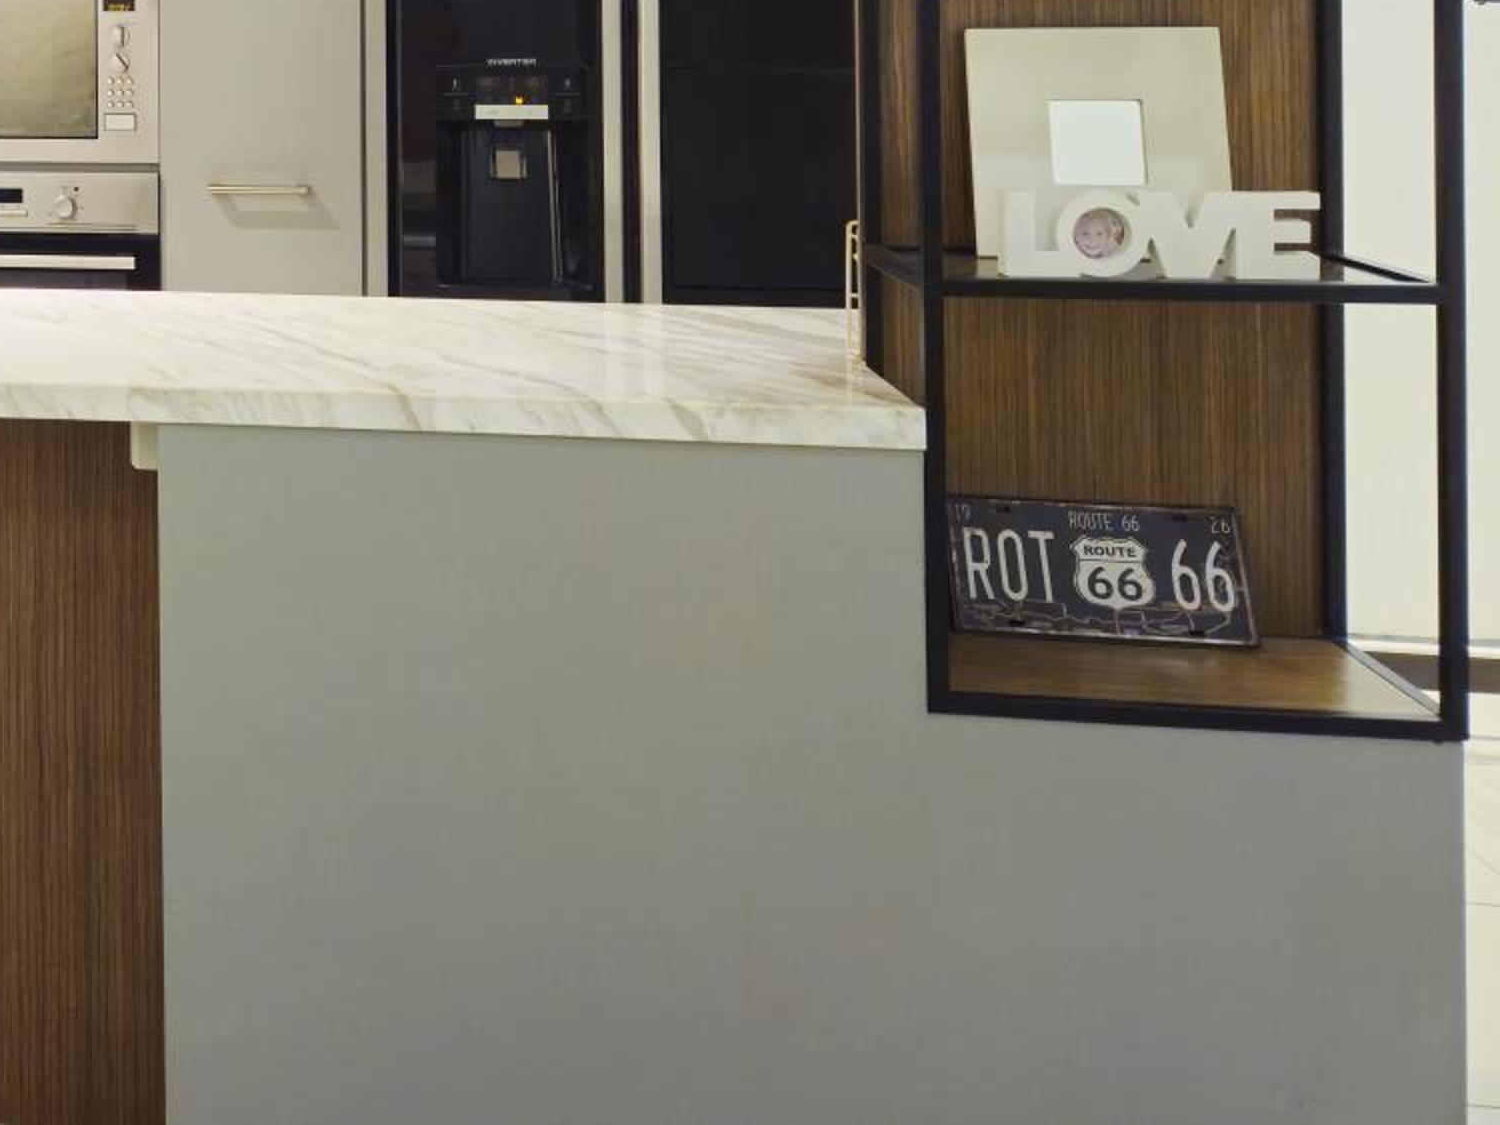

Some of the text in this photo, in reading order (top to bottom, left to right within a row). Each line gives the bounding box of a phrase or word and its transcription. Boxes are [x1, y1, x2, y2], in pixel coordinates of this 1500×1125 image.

[485, 58, 537, 68] INVERTER
[998, 190, 1321, 279] LOVE
[1067, 511, 1141, 532] ROUTE 66
[963, 526, 1054, 604] ROT
[1082, 544, 1138, 559] ROUTE
[1086, 566, 1145, 602] 66
[1170, 538, 1236, 613] 66
